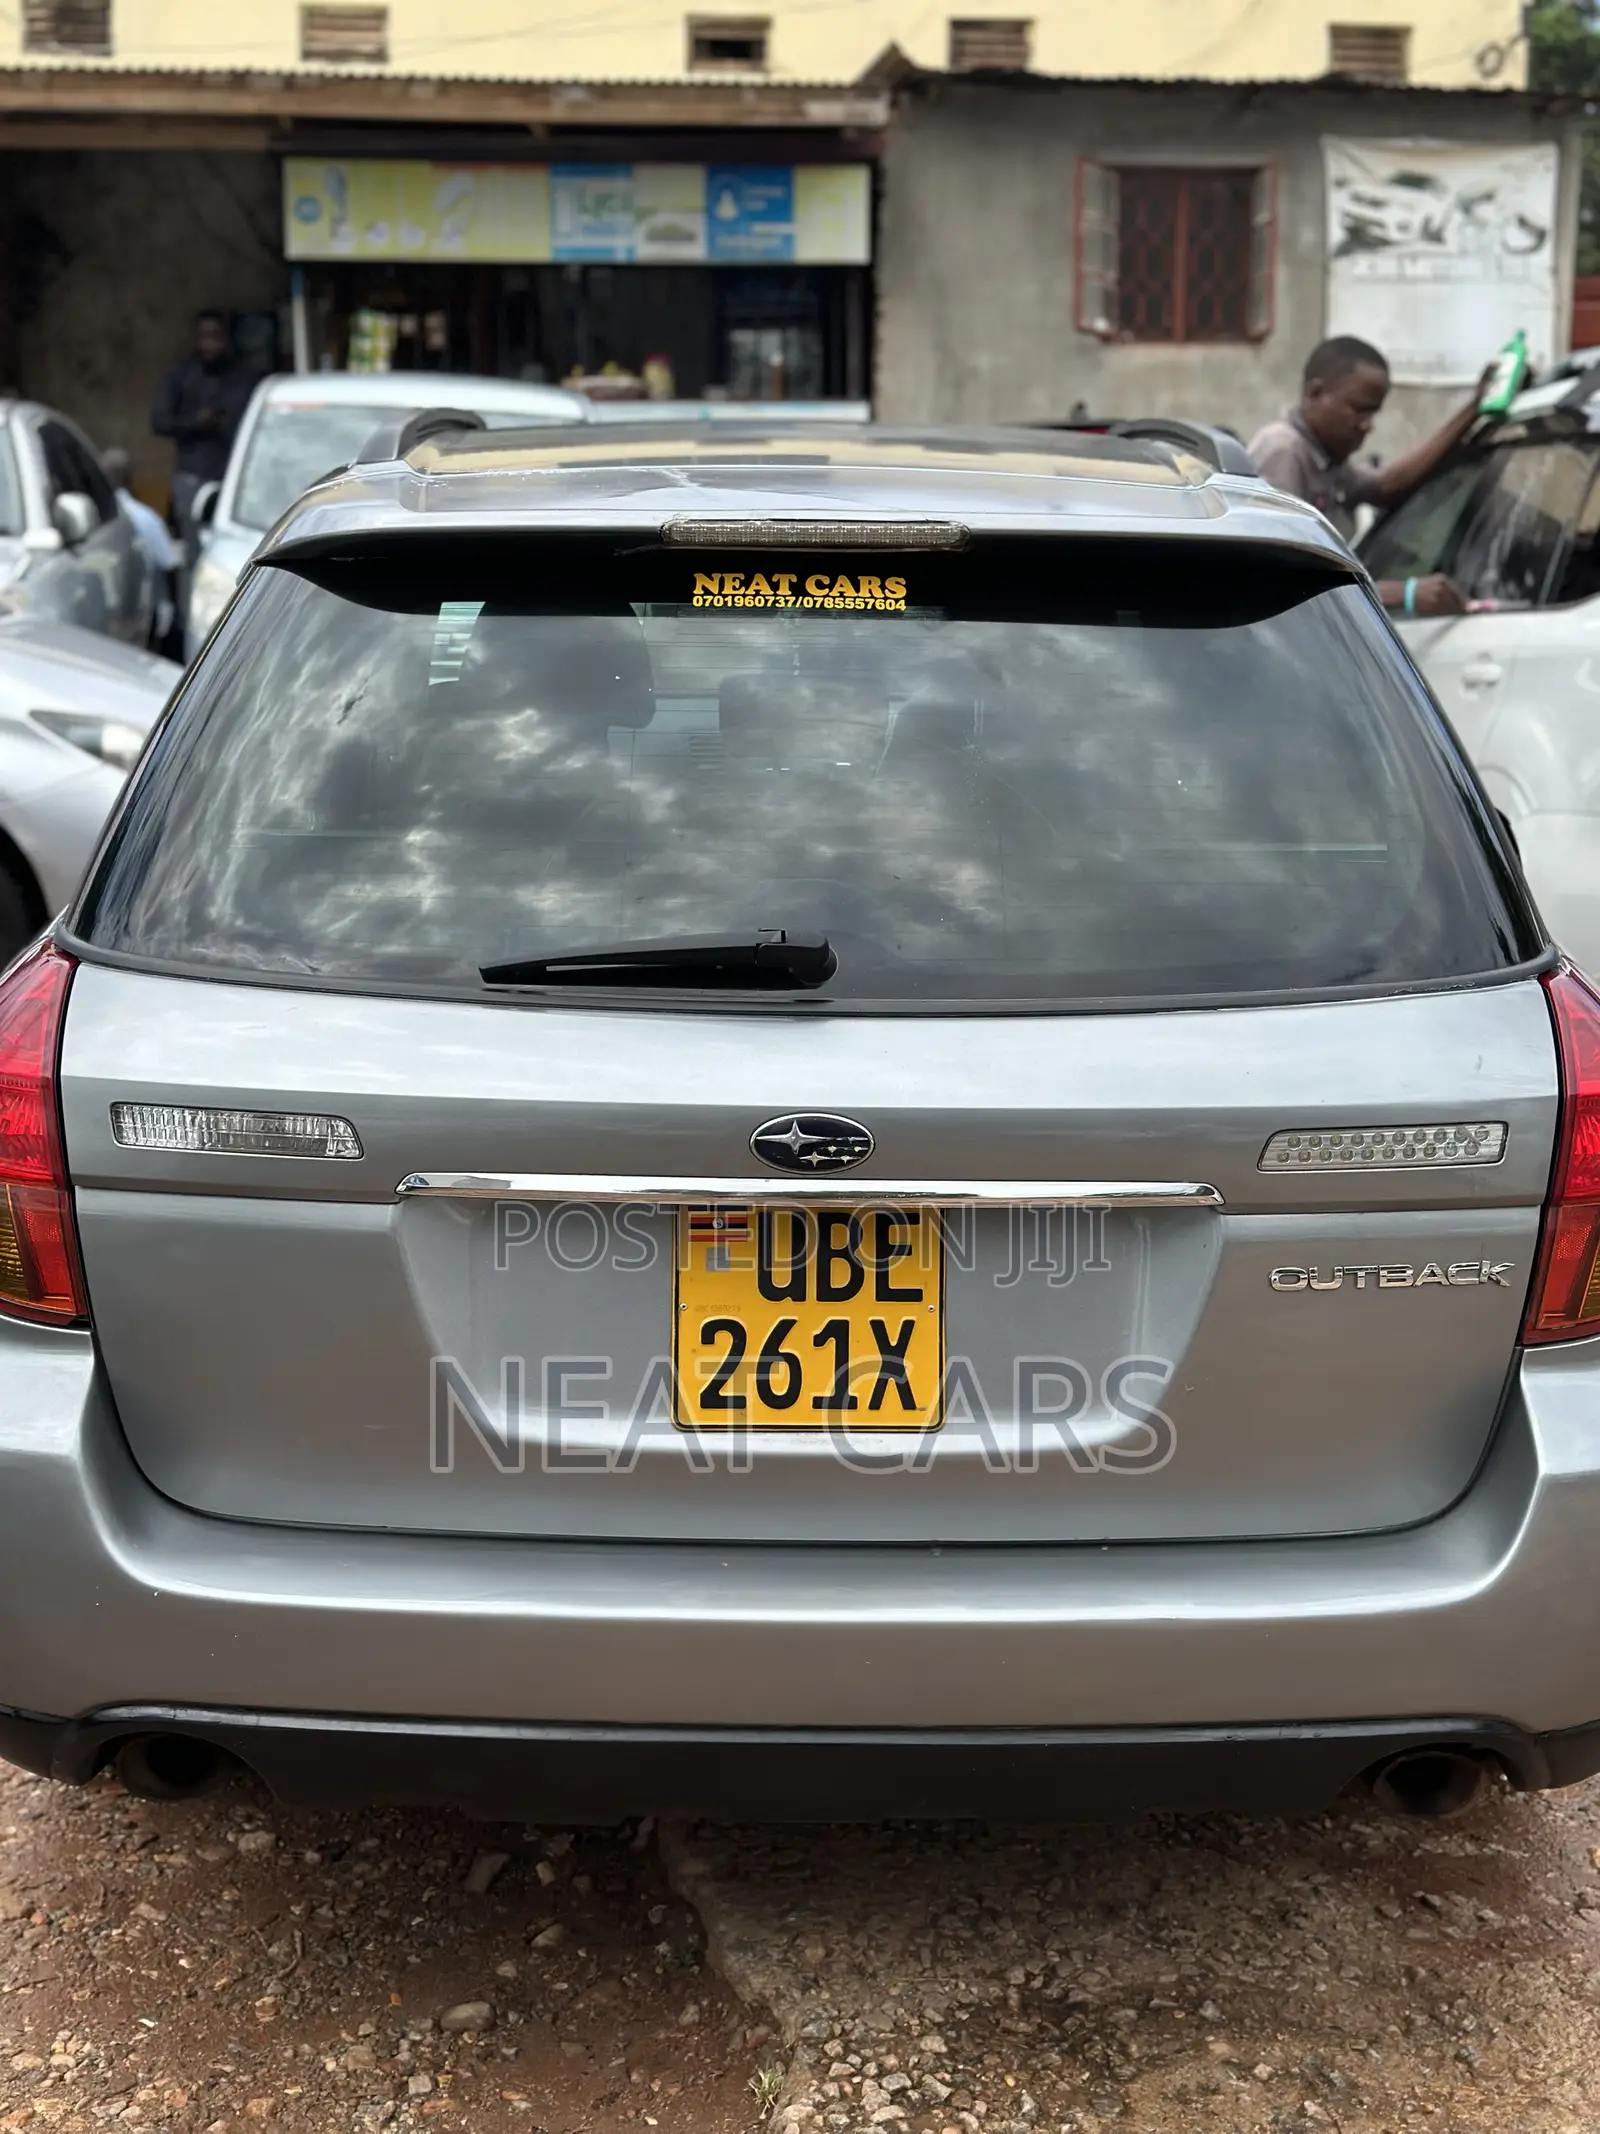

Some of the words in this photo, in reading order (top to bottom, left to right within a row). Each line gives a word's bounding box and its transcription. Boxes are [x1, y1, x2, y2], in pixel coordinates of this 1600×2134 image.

[693, 573, 797, 595] NEAT
[805, 574, 907, 598] CARS
[692, 595, 907, 610] 0701960737/0785557604
[757, 1212, 924, 1302] UBE
[1268, 1260, 1515, 1291] OUTBACK
[699, 1318, 917, 1411] 261X
